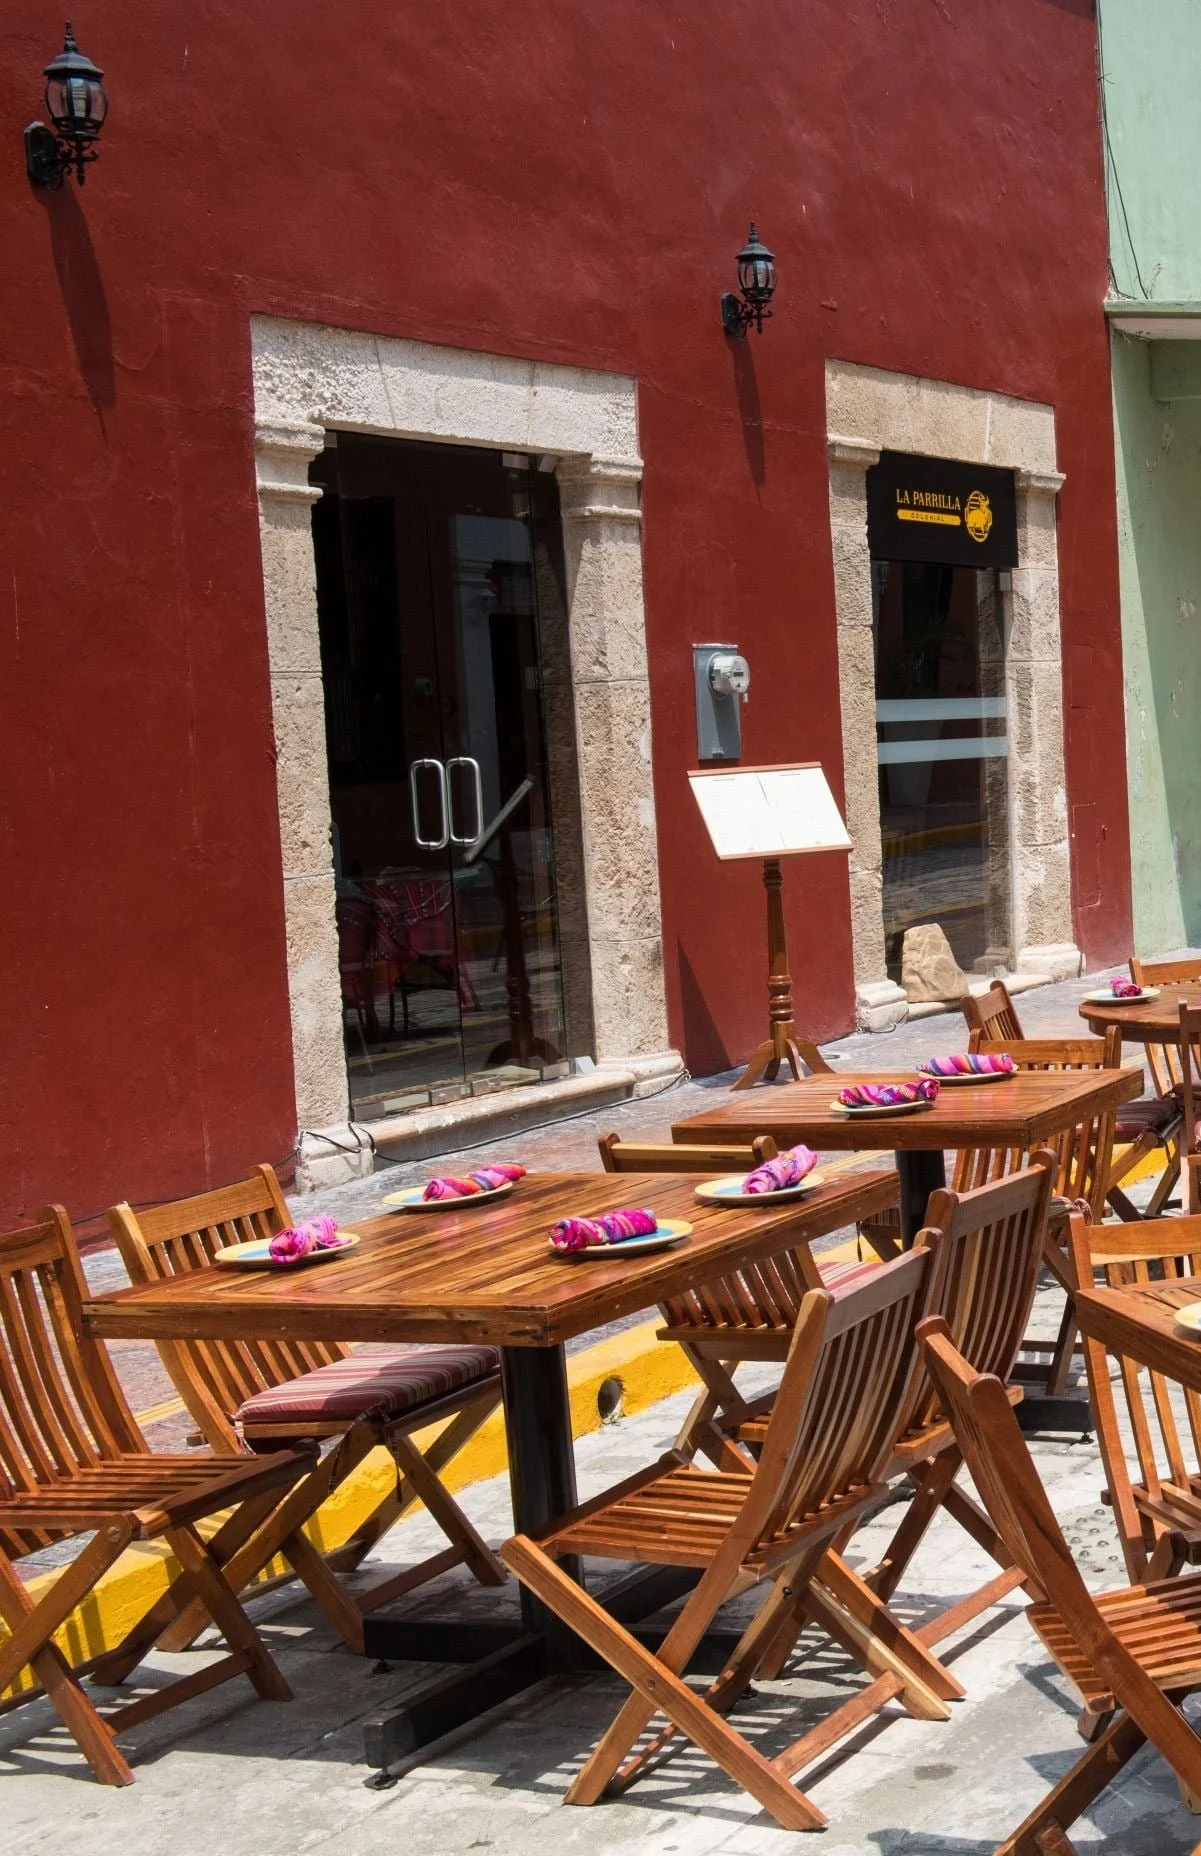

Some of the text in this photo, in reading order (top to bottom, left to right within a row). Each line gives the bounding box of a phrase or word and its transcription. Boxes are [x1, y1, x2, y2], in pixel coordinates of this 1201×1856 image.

[896, 489, 961, 510] LA PARRILLA
[911, 512, 945, 522] COLONIAL
